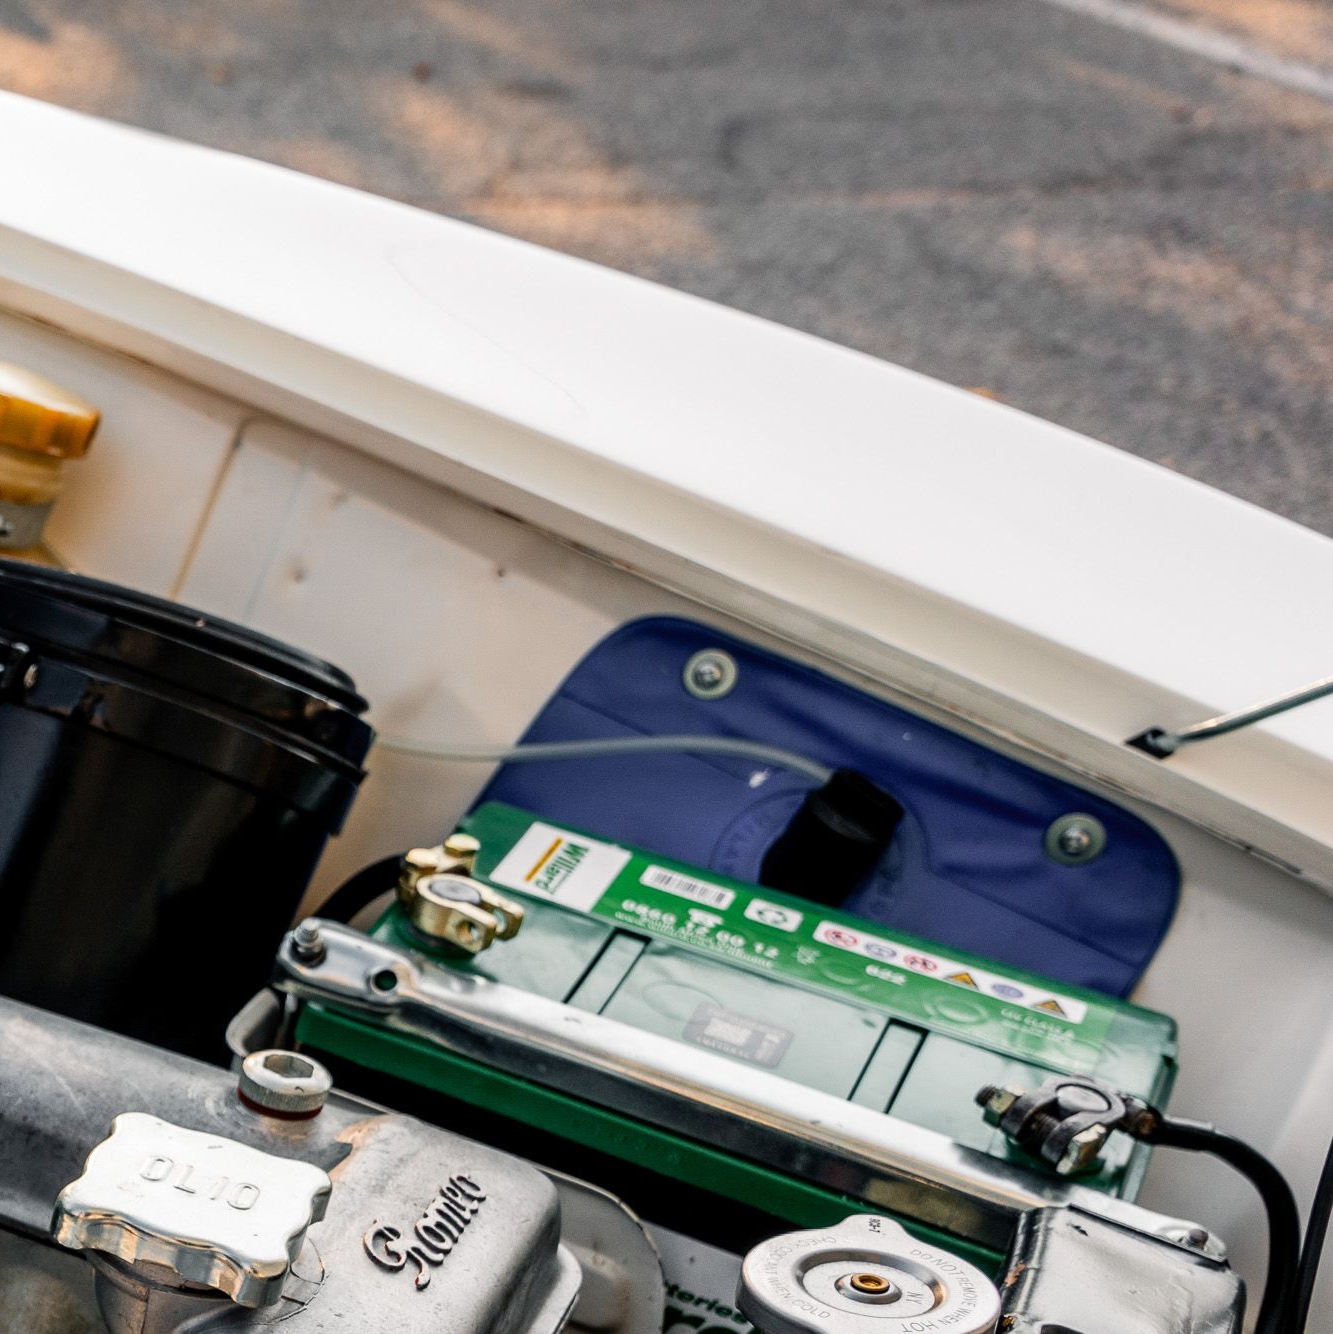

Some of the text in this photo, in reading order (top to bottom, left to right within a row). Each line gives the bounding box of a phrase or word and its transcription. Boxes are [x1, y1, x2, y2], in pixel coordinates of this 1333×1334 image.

[139, 1154, 262, 1212] OLIO
[791, 1298, 831, 1319] COLD
[901, 1249, 978, 1333] DO NOT REMOVE WHEN HOT
